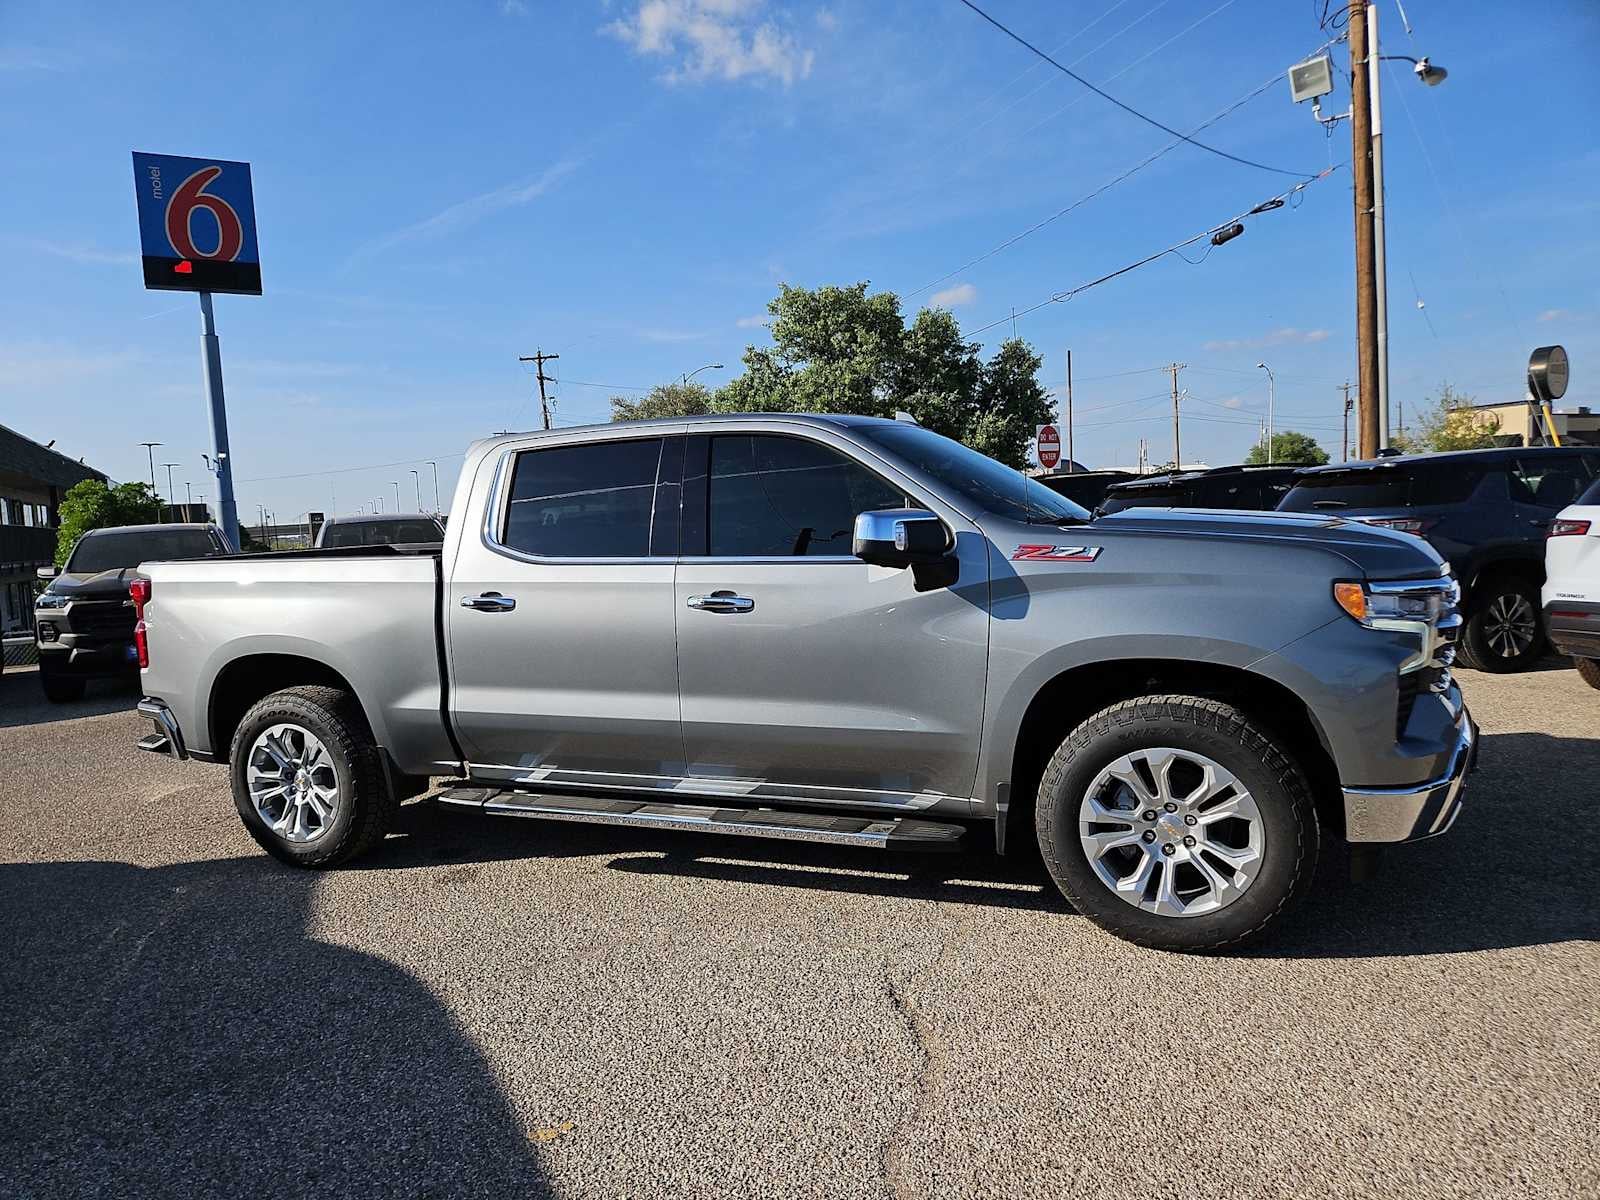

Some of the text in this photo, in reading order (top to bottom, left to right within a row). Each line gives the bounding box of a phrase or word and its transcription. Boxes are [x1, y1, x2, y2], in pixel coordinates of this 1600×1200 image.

[147, 166, 163, 199] motel
[165, 166, 243, 262] 6
[1040, 433, 1057, 441] DO NOT
[1041, 452, 1057, 461] ENTER
[1012, 544, 1104, 562] Z71
